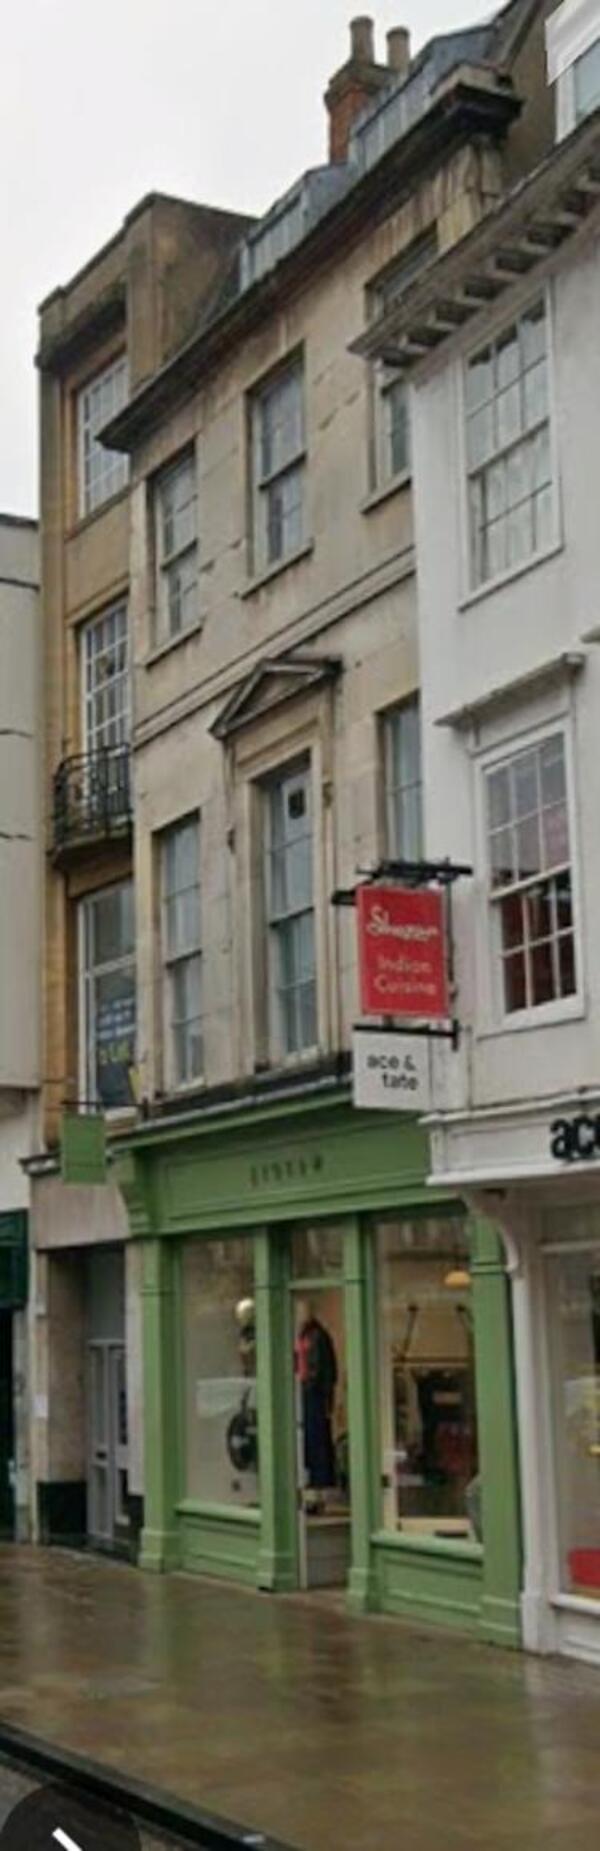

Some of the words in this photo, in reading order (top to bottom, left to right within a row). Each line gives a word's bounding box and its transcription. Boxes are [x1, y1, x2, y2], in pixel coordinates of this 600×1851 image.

[378, 955, 432, 973] Indian
[374, 974, 436, 995] Cuisine
[367, 1054, 399, 1069] ace
[404, 1054, 416, 1071] &
[382, 1072, 419, 1091] tate
